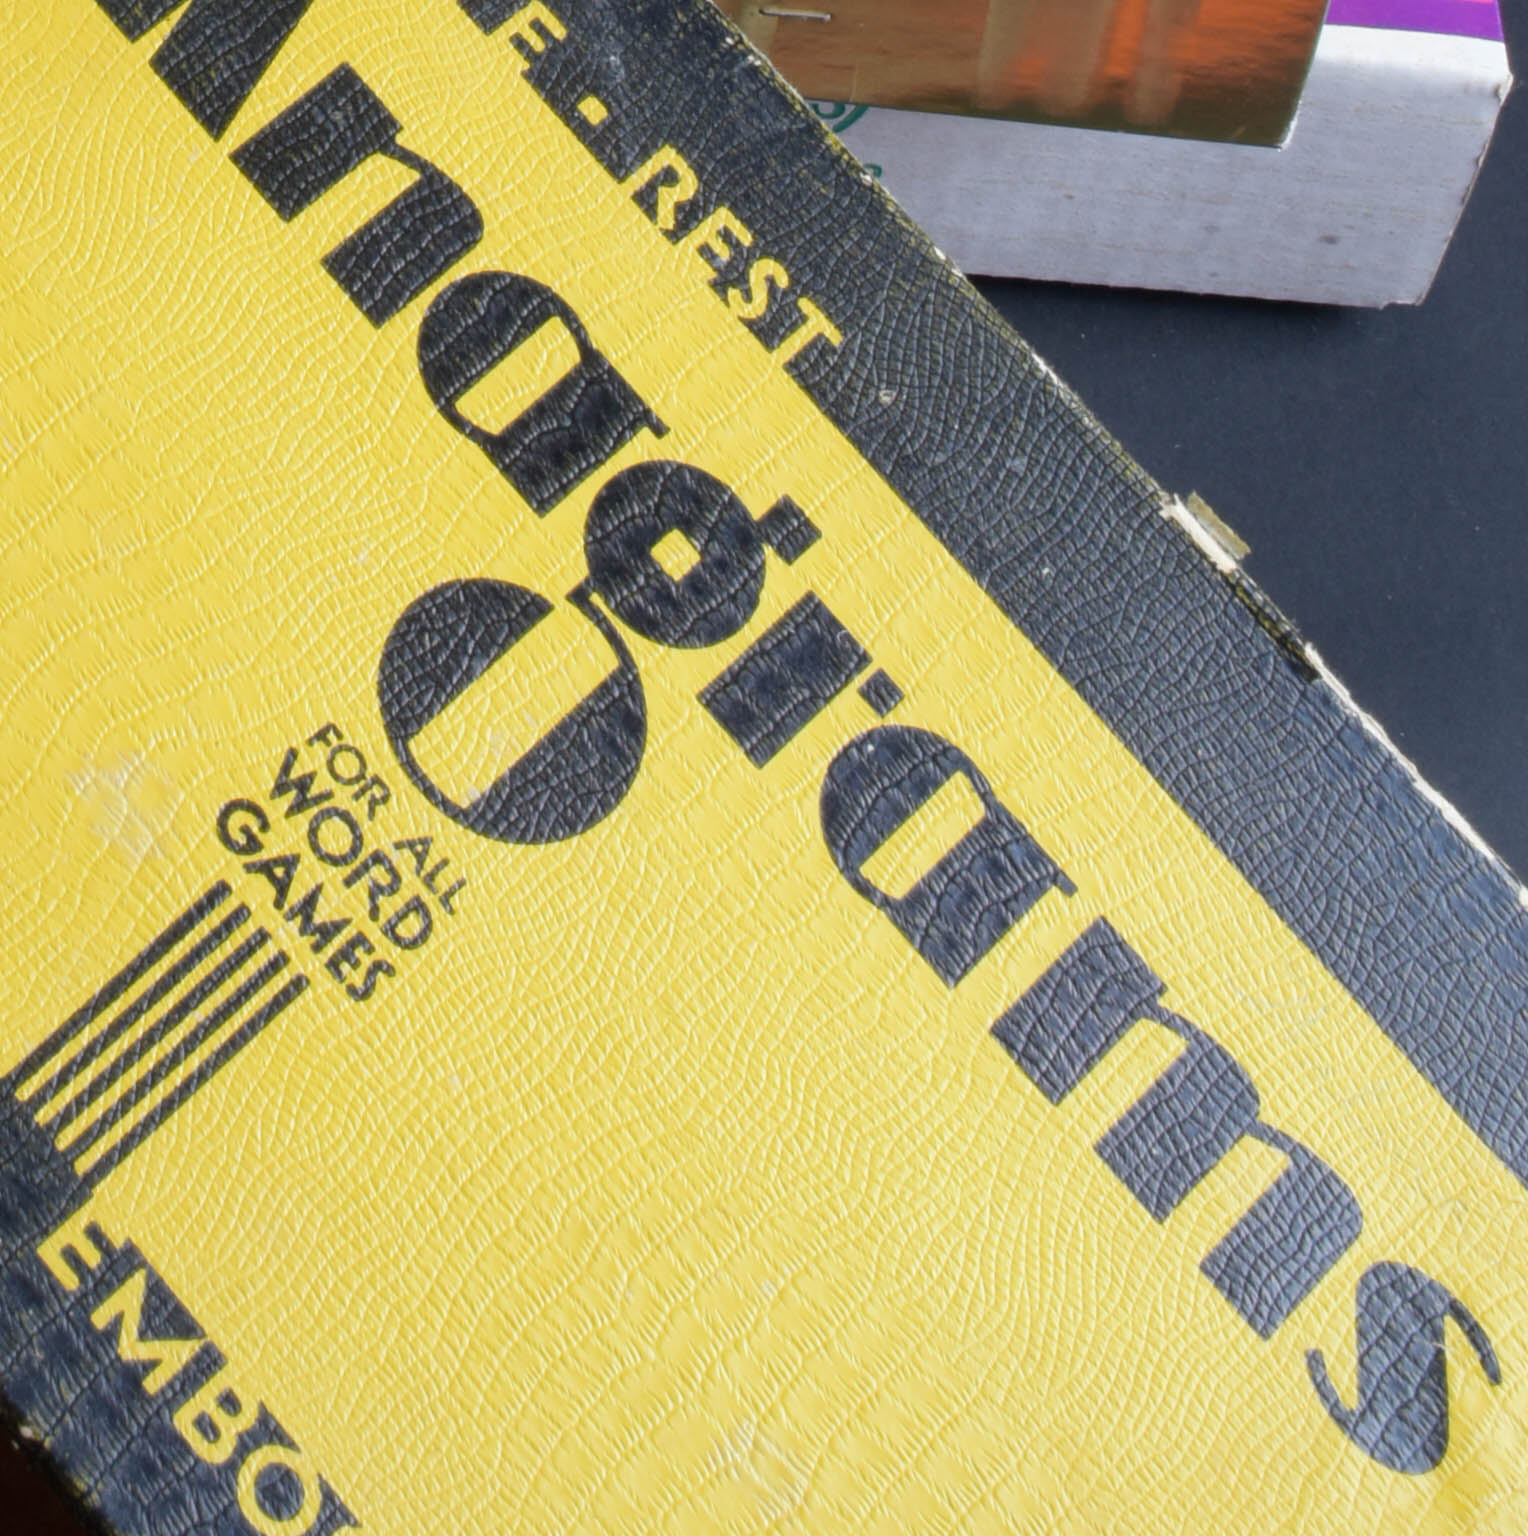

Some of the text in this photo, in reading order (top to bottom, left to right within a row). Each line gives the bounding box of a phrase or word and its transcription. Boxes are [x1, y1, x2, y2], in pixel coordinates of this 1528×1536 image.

[214, 797, 399, 1004] GAMES
[268, 746, 435, 955] WORD
[306, 722, 468, 916] FOR ALL
[36, 1218, 342, 1536] EMBO
